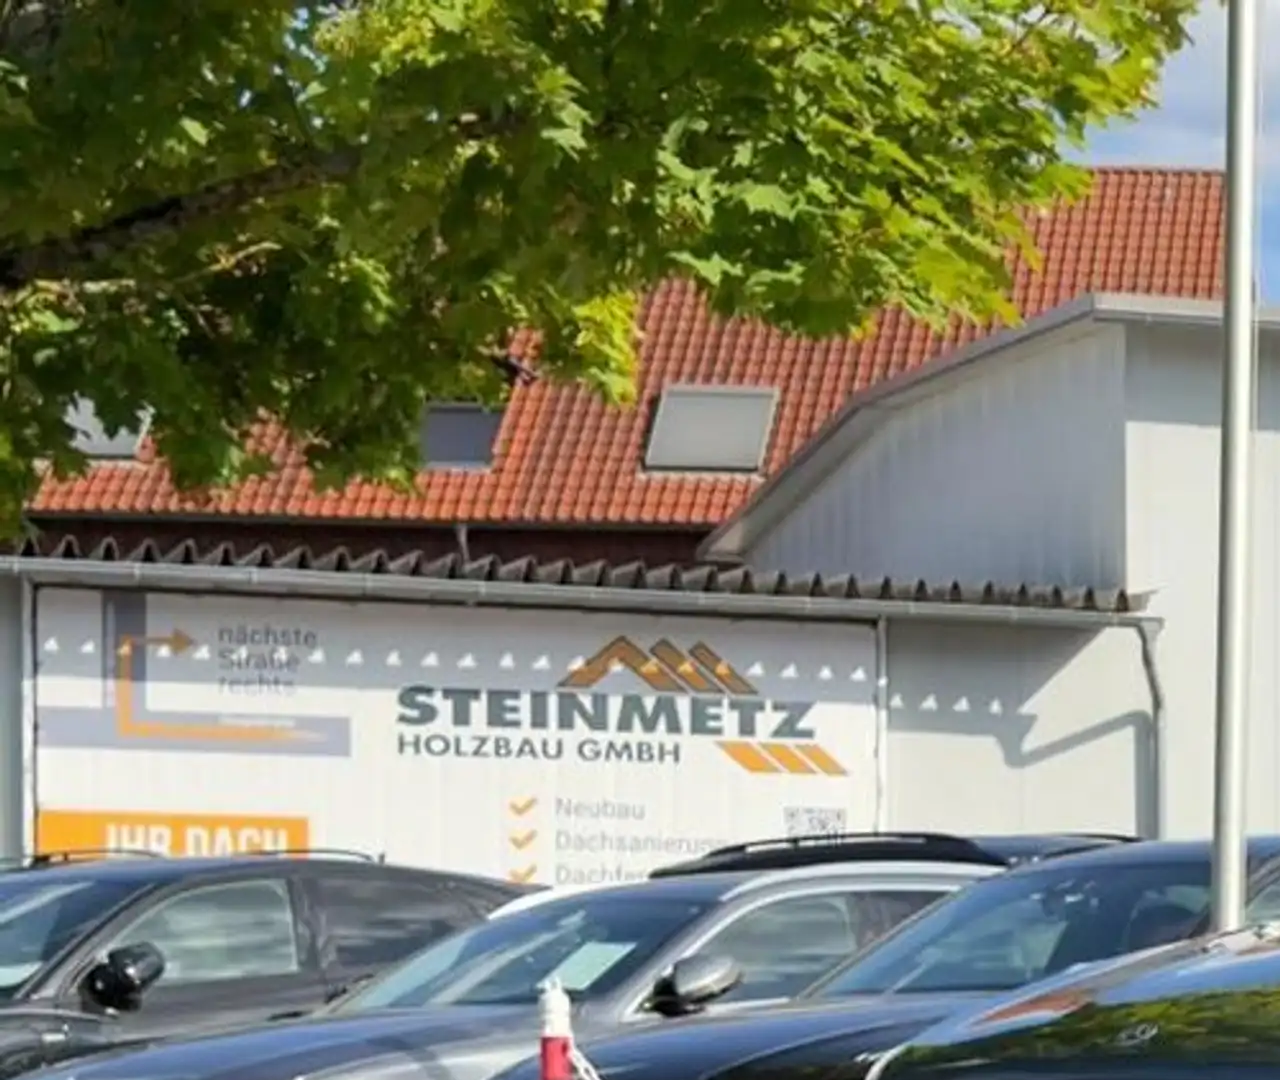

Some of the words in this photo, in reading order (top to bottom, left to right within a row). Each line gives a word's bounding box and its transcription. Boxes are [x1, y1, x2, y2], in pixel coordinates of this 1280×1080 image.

[218, 624, 317, 649] nächste
[398, 685, 817, 739] STEINMETZ
[397, 732, 565, 761] HOLZBAU
[577, 736, 682, 764] GMBH
[555, 798, 646, 820] Neubau
